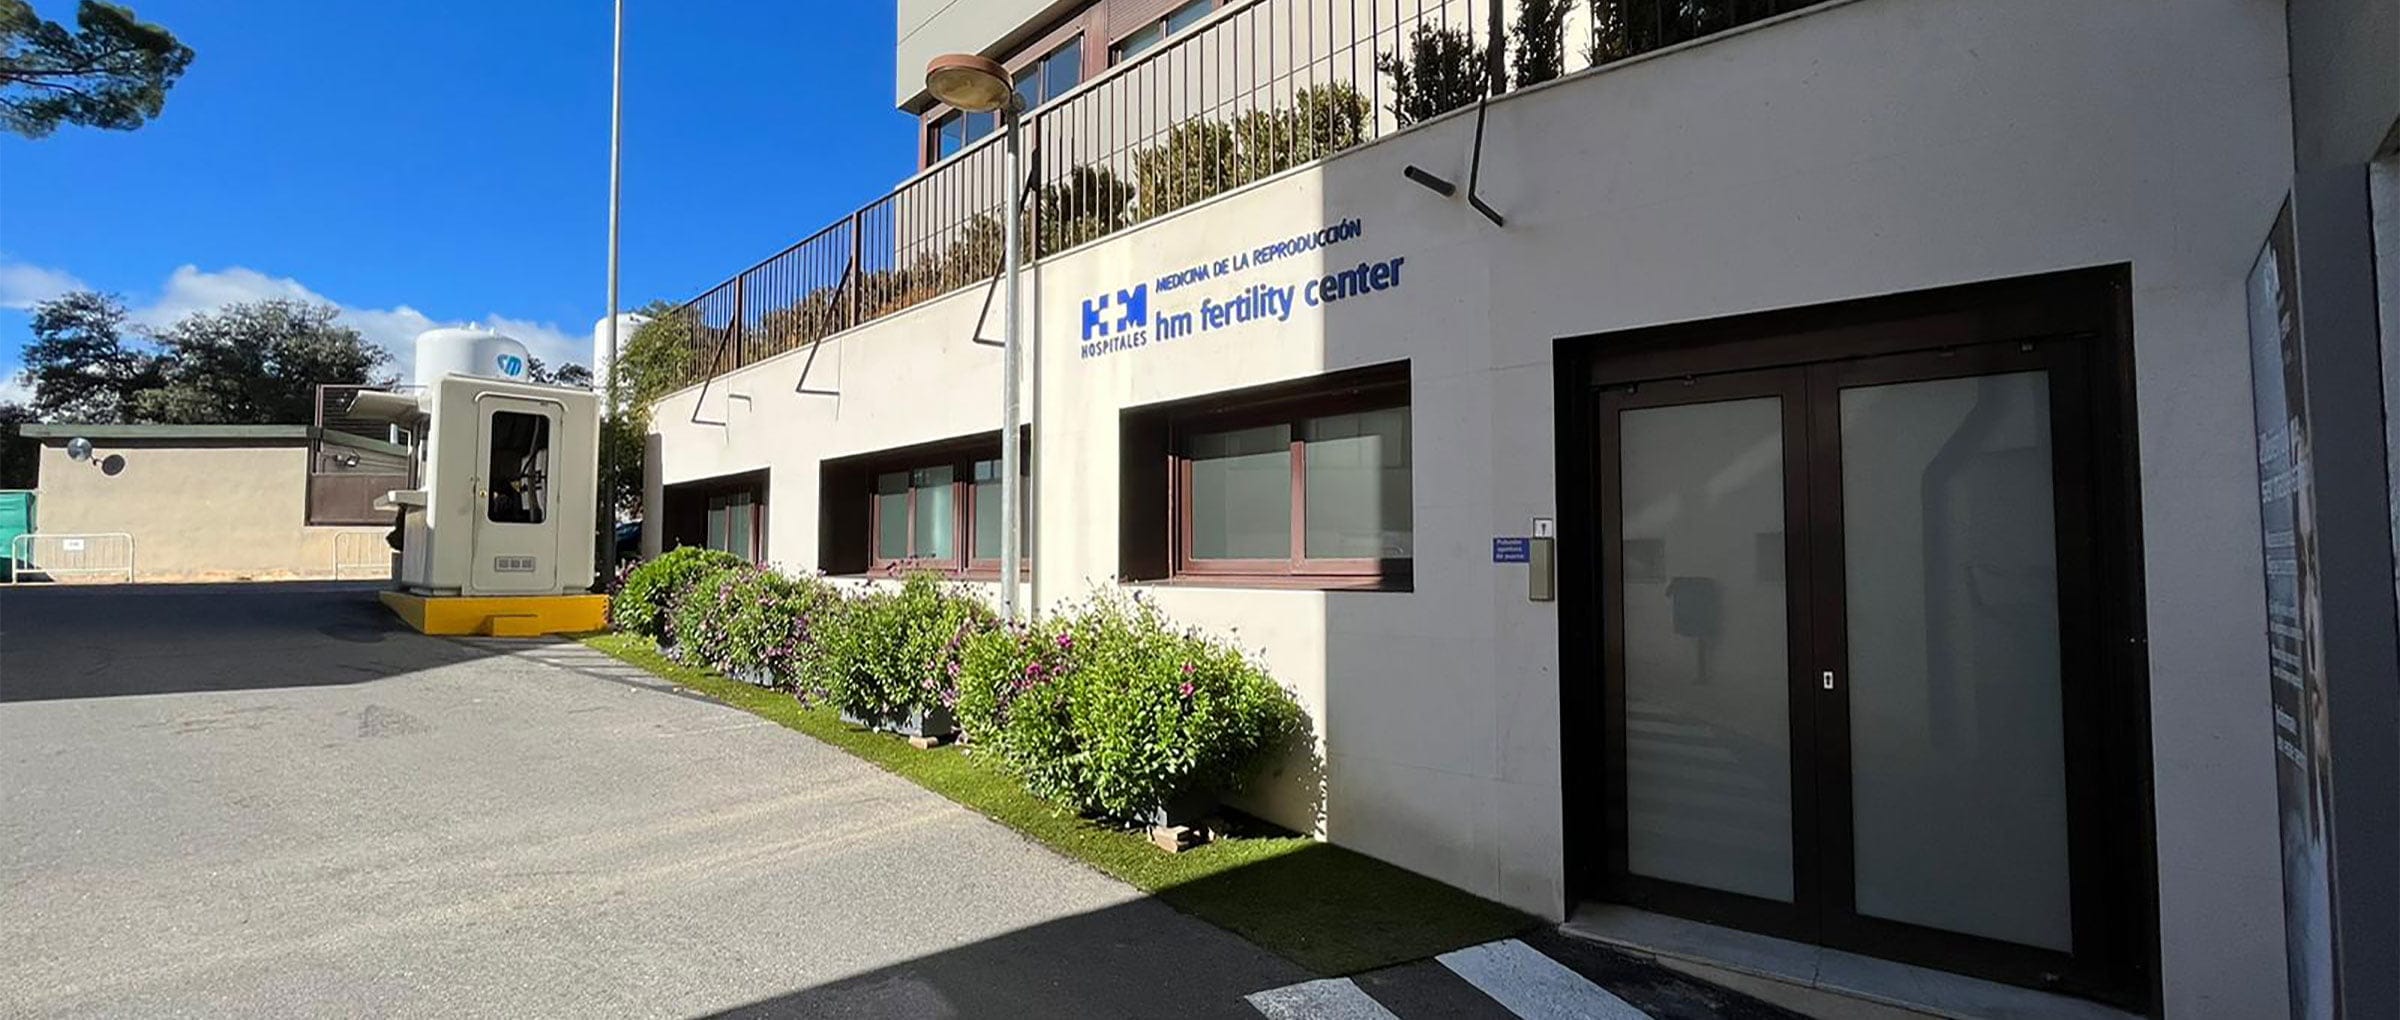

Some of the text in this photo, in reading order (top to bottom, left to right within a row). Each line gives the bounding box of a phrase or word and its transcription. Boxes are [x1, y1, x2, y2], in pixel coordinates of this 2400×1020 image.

[1155, 218, 1361, 293] MEDICINA DE LA REPRODUCCIÓN
[1081, 283, 1147, 342] HM
[1155, 256, 1404, 342] hm fertility center
[1081, 330, 1147, 359] HOSPITALES
